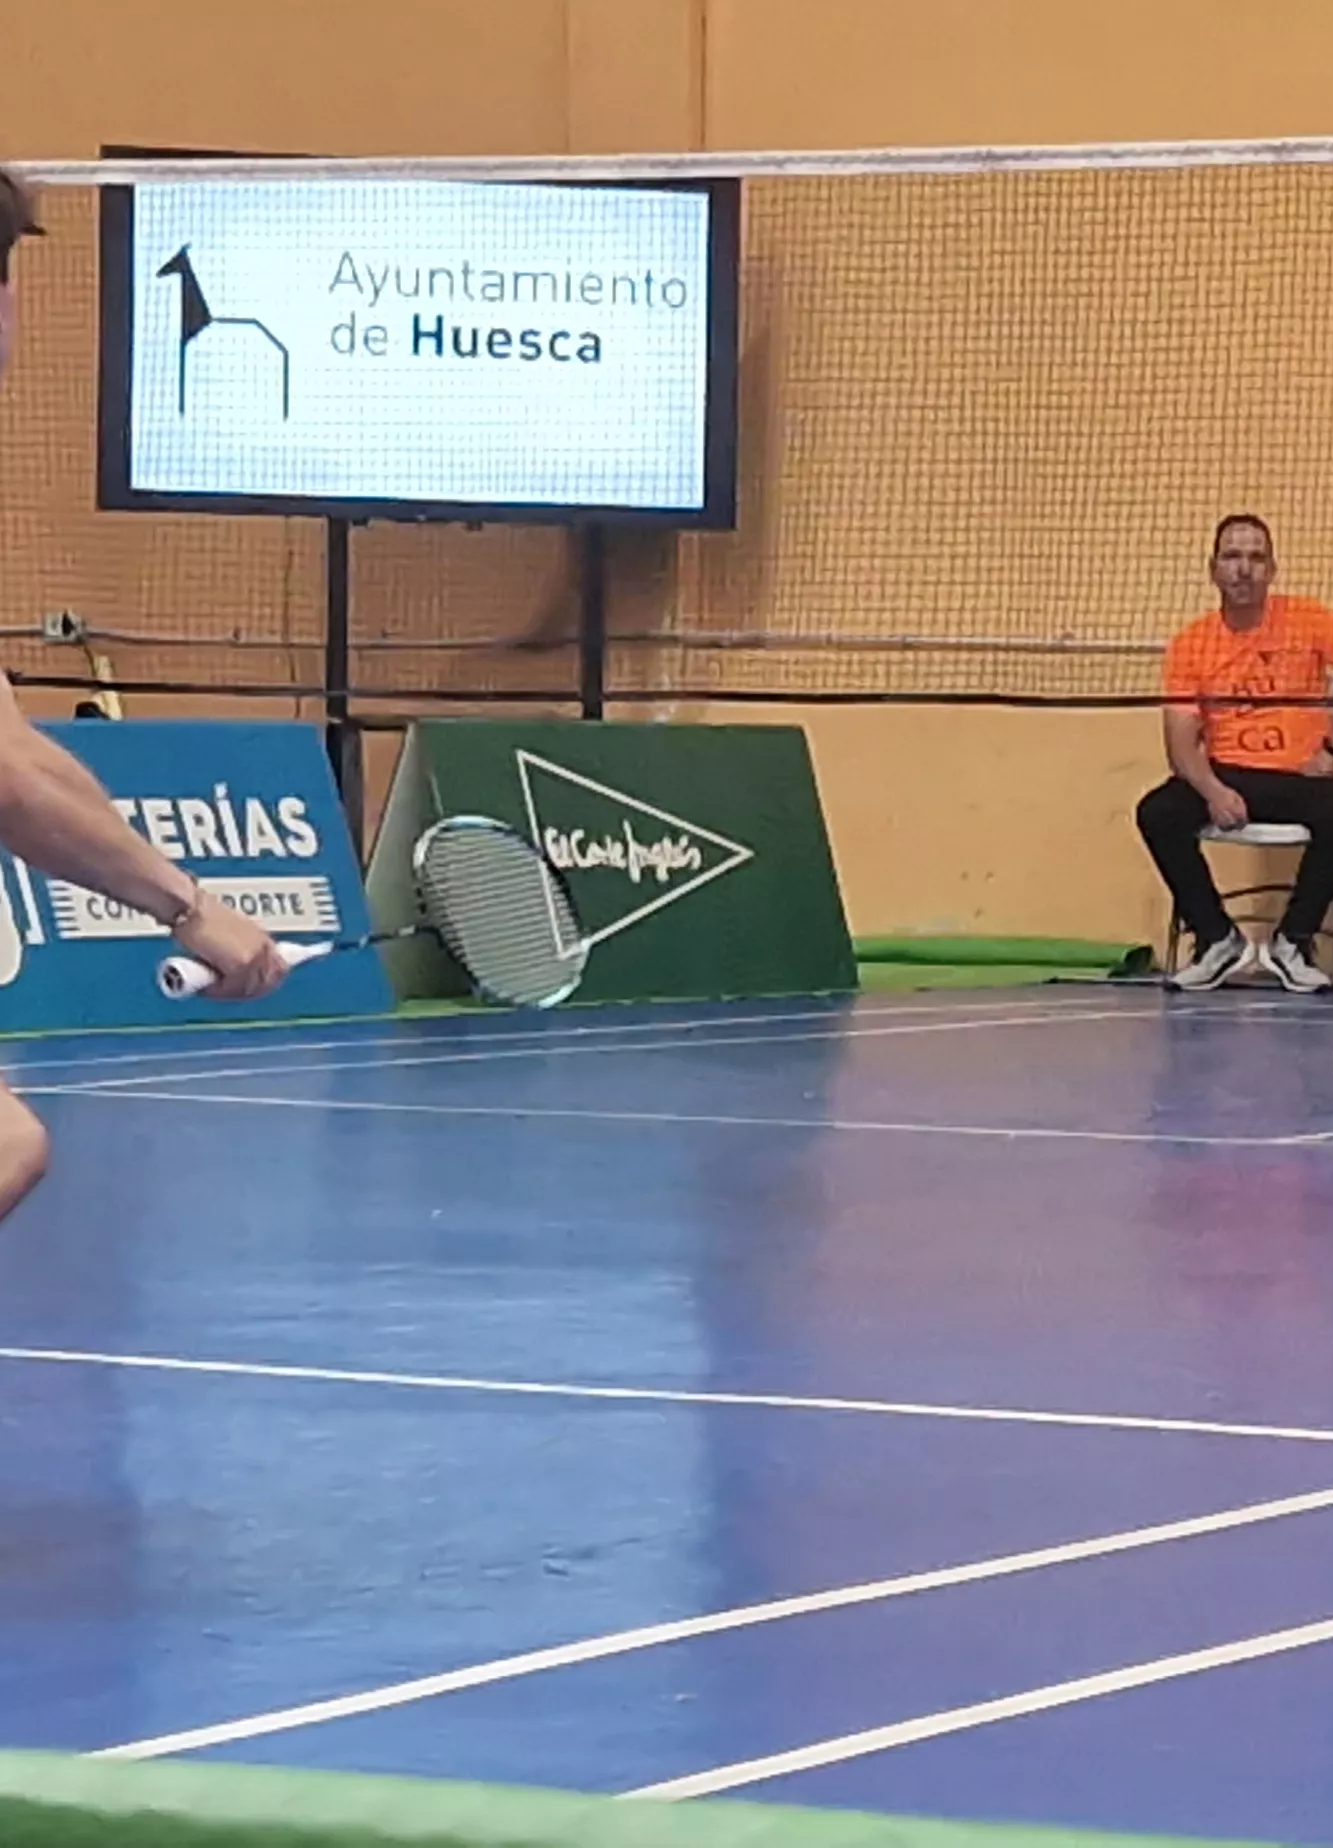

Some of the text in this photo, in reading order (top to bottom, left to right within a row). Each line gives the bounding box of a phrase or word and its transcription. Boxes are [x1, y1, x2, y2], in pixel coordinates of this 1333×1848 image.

[328, 251, 689, 310] Ayuntamiento
[330, 311, 602, 364] de Huesca
[110, 781, 318, 857] TERÍAS
[221, 893, 305, 917] PORTE
